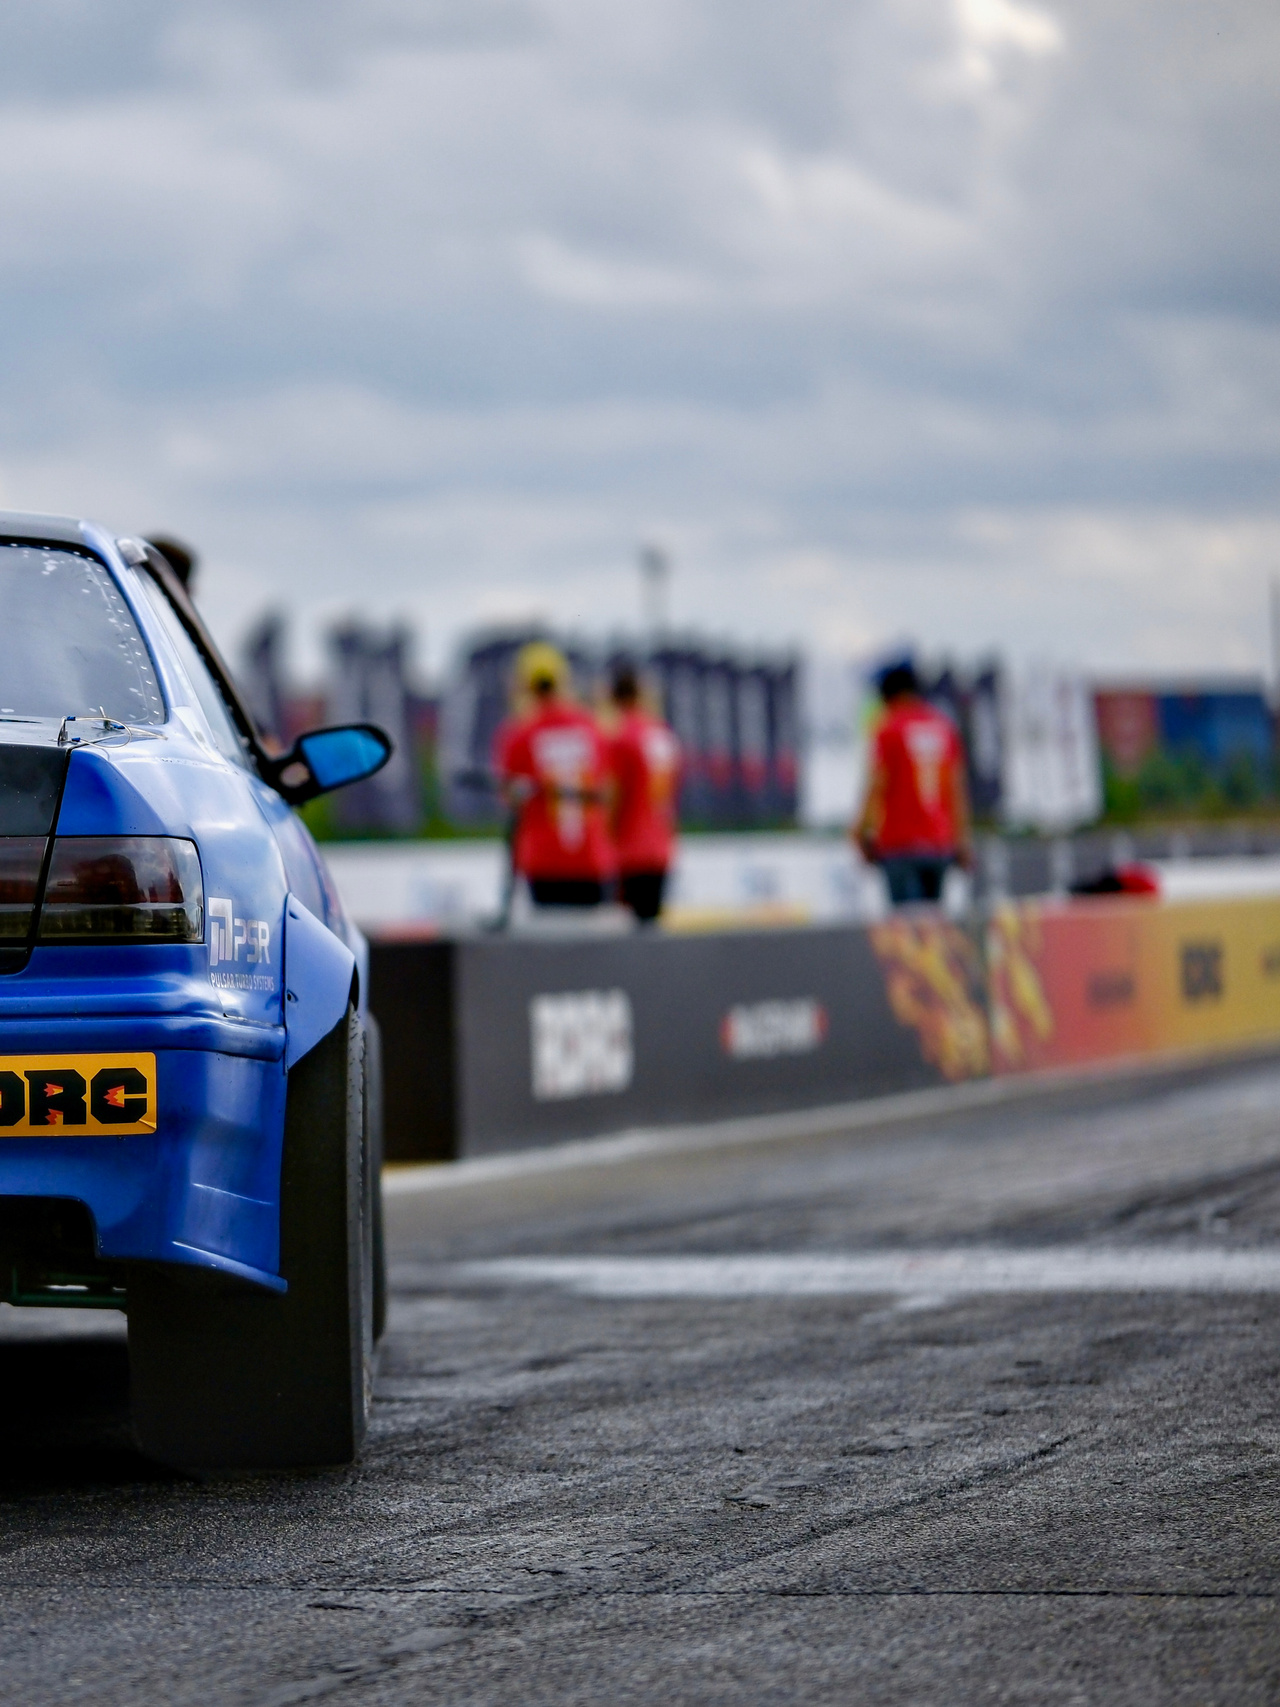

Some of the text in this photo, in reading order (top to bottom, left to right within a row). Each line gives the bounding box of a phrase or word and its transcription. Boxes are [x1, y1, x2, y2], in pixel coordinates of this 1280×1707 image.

[211, 972, 275, 991] PULSAR TURBO SYSTEMS
